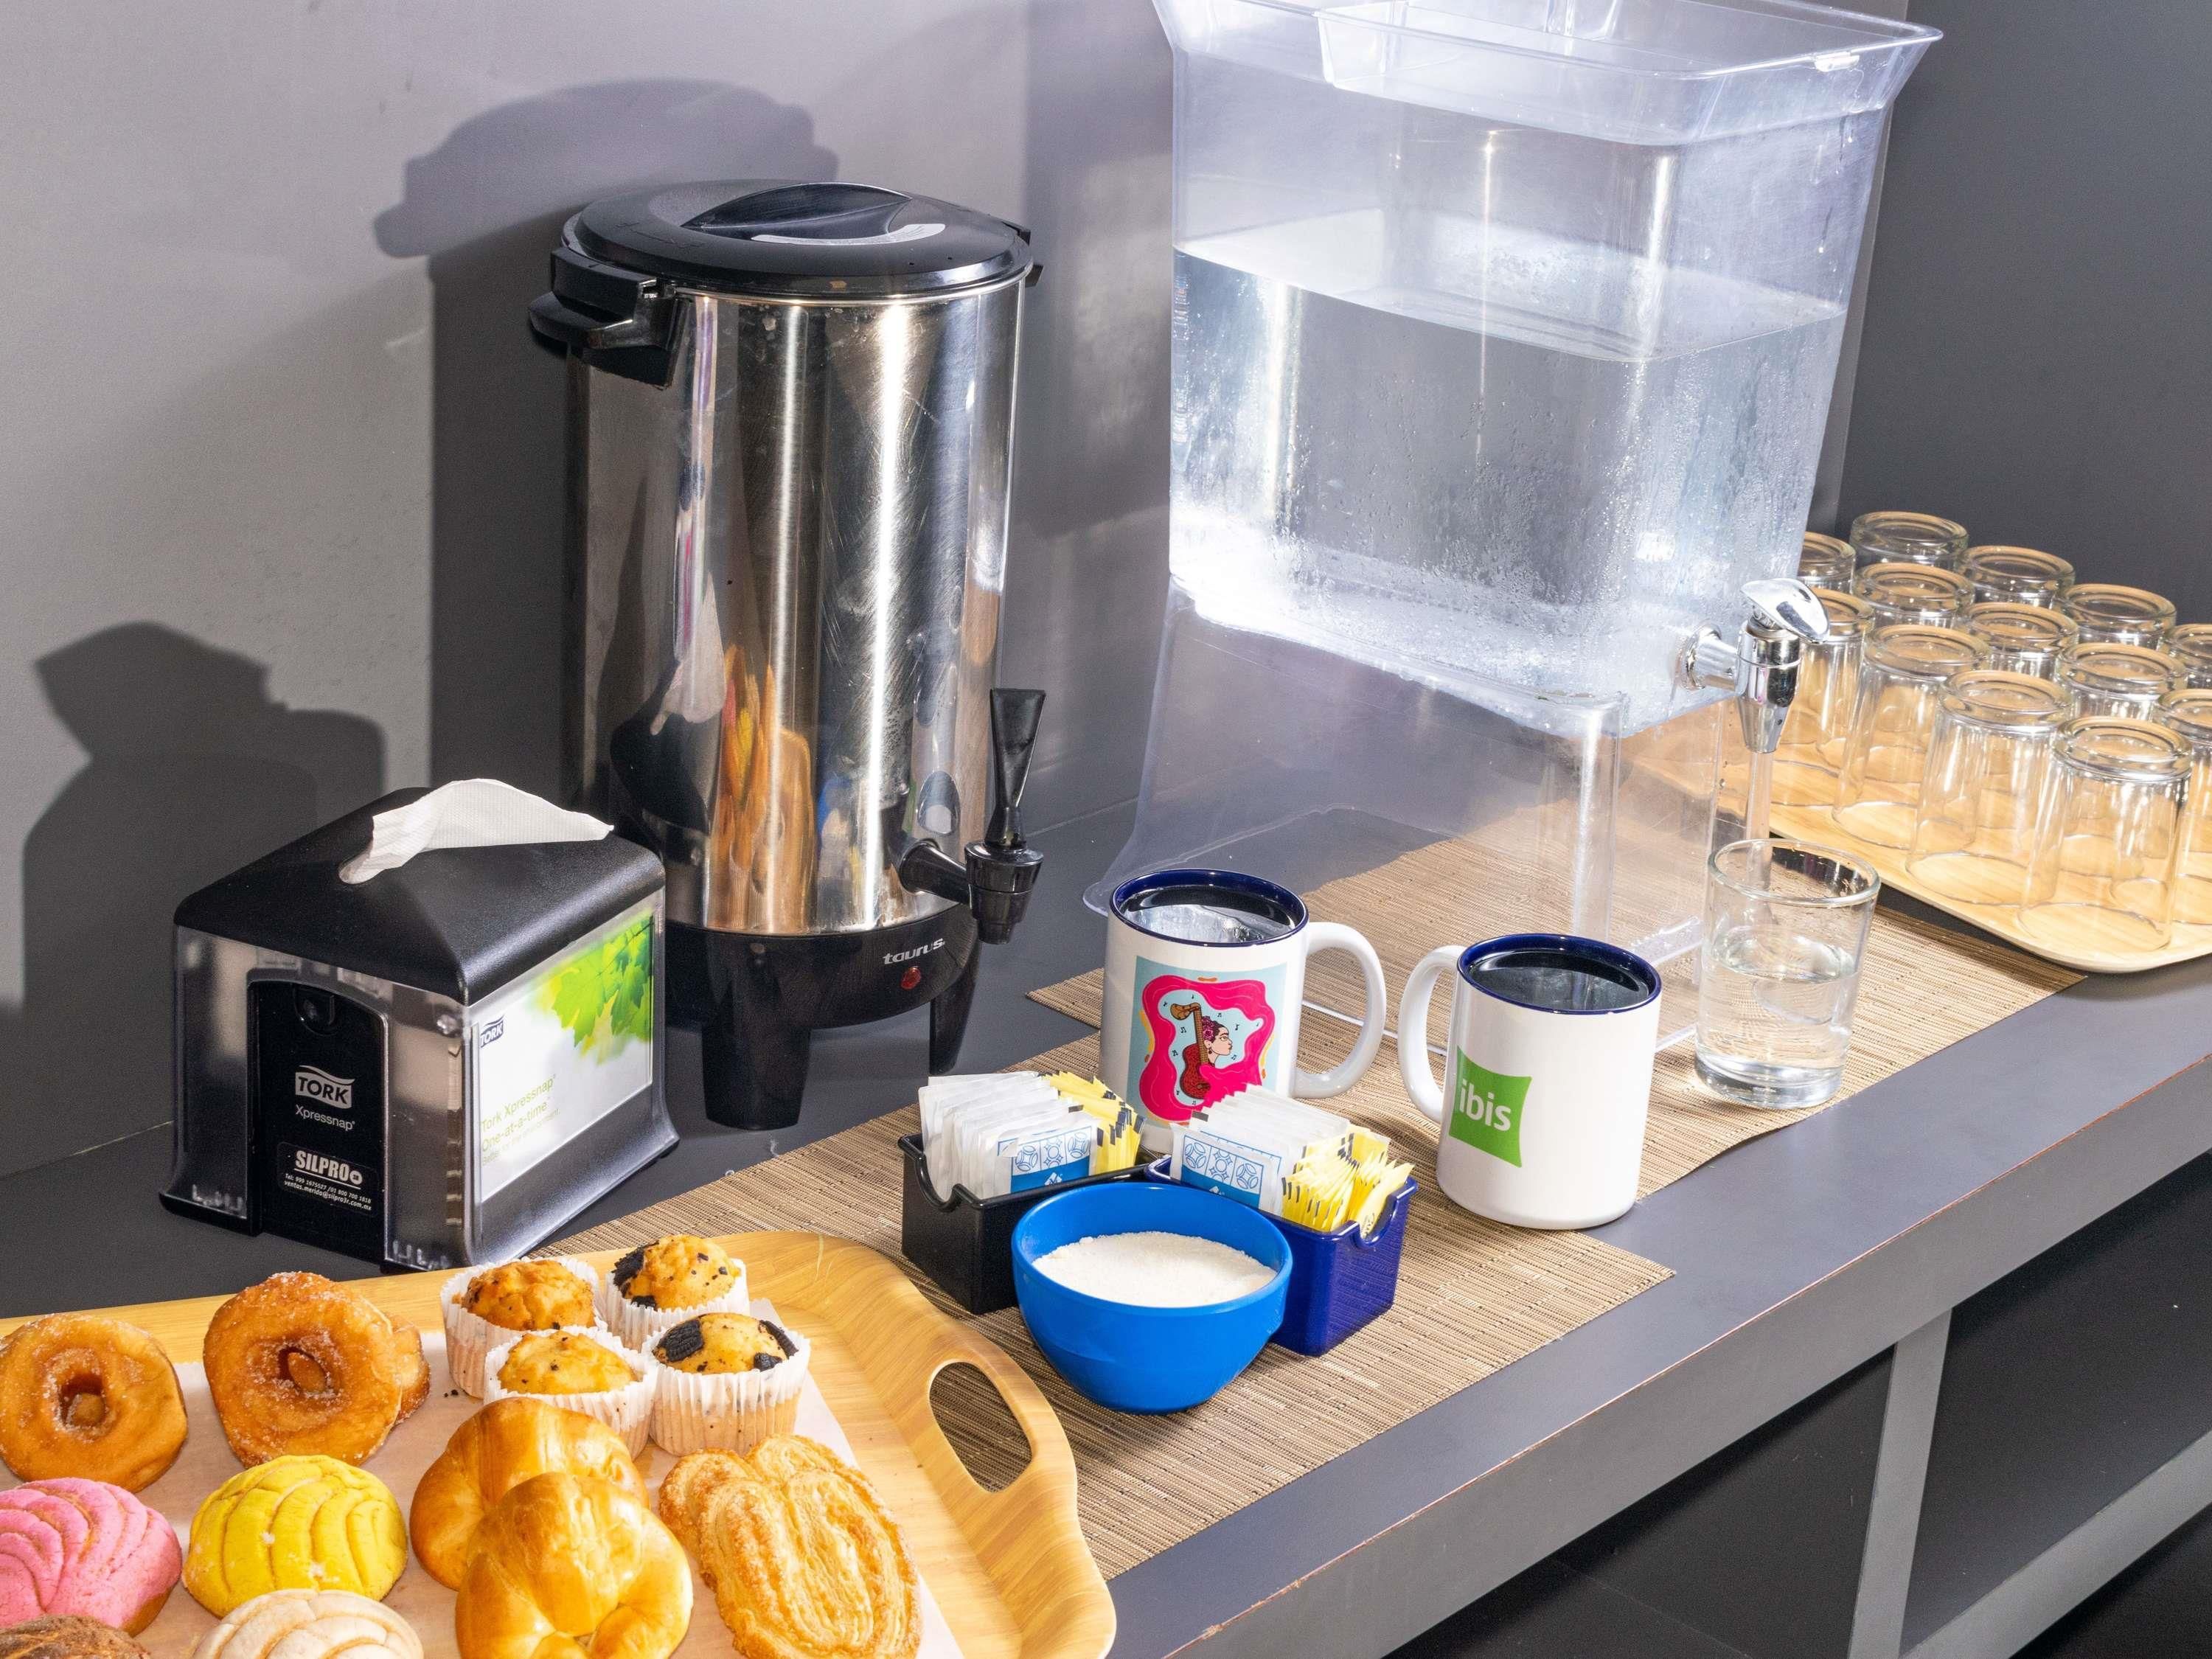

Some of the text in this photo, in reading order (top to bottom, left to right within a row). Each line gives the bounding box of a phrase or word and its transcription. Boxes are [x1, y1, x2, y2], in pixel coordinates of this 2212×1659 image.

[883, 938, 945, 964] taurus
[480, 1023, 504, 1047] TORK
[298, 1076, 349, 1105] TORK
[1459, 1078, 1511, 1132] ibis
[481, 1110, 502, 1132] Tork
